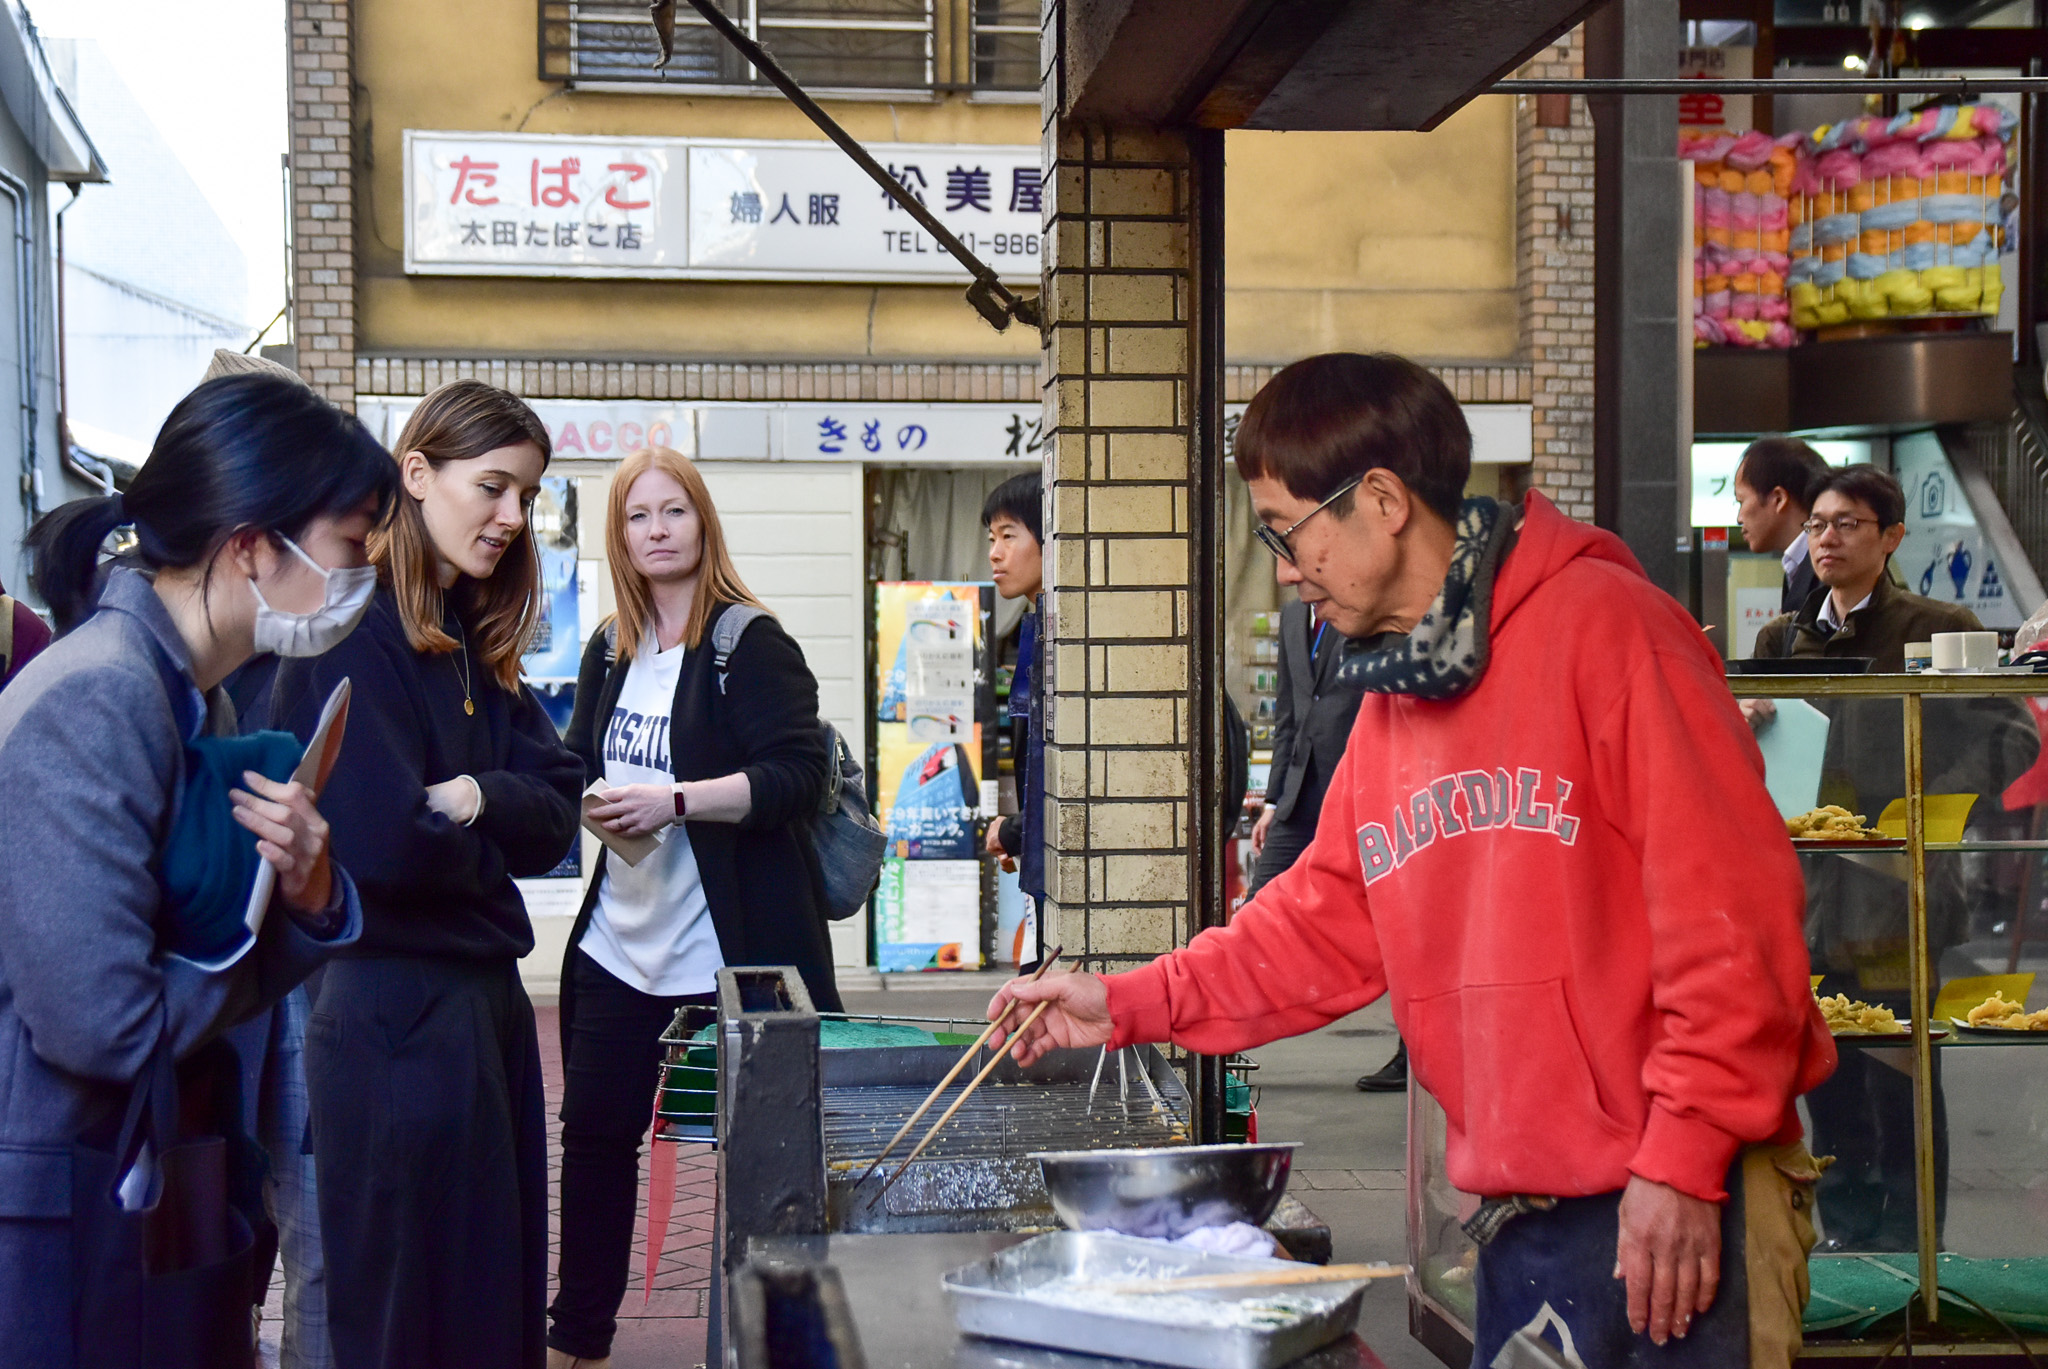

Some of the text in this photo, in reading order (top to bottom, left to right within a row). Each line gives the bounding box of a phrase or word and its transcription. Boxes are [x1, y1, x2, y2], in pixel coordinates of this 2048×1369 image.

[450, 155, 651, 209] たばこ
[730, 191, 840, 225] 婦人服
[460, 220, 643, 250] 太田たばこ店
[883, 231, 928, 253] TEL
[543, 420, 673, 453] ACCO
[818, 416, 927, 453] きもの
[603, 706, 675, 775] RSEIL
[1356, 766, 1581, 887] BABYDOLL
